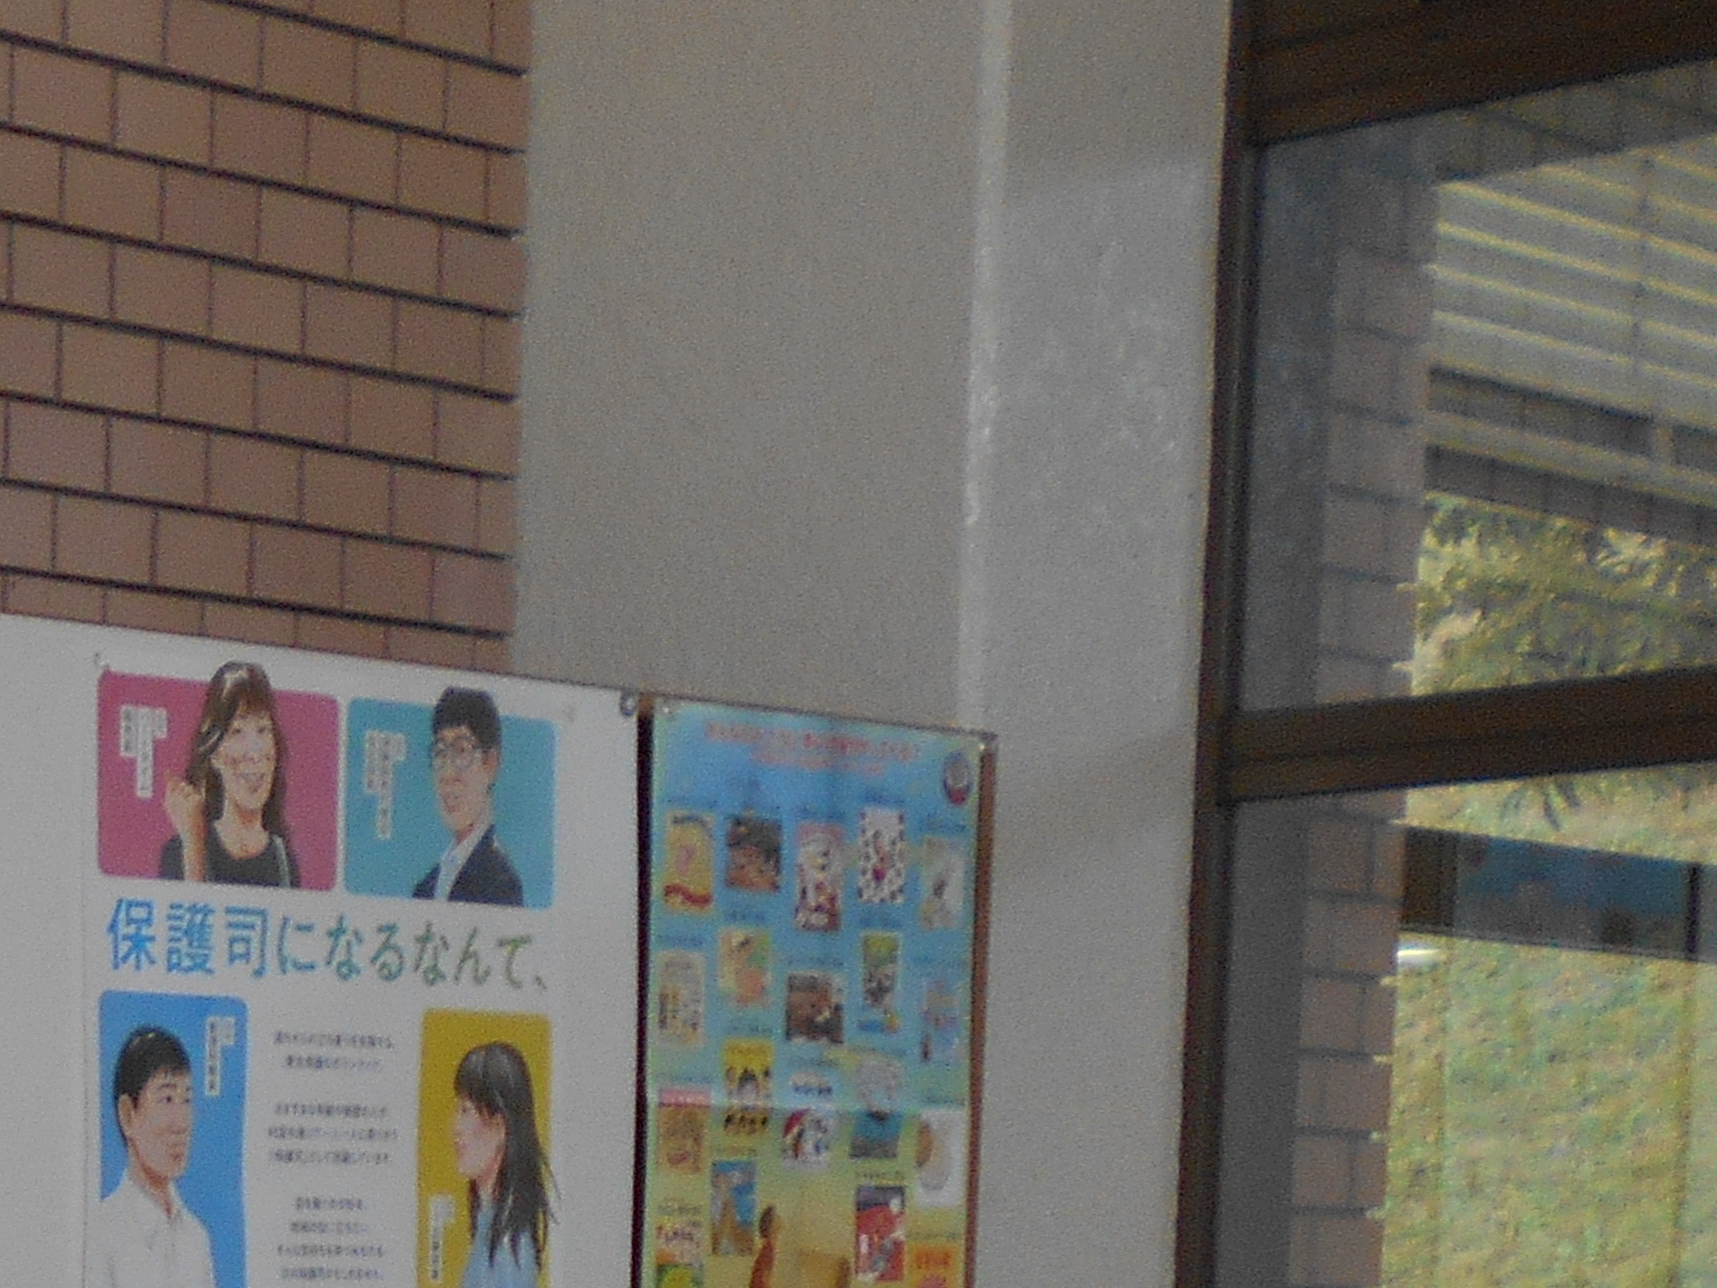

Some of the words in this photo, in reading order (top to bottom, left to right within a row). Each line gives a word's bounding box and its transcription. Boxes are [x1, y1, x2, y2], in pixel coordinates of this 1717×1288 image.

[106, 896, 550, 990] 保護司になるなんて、
